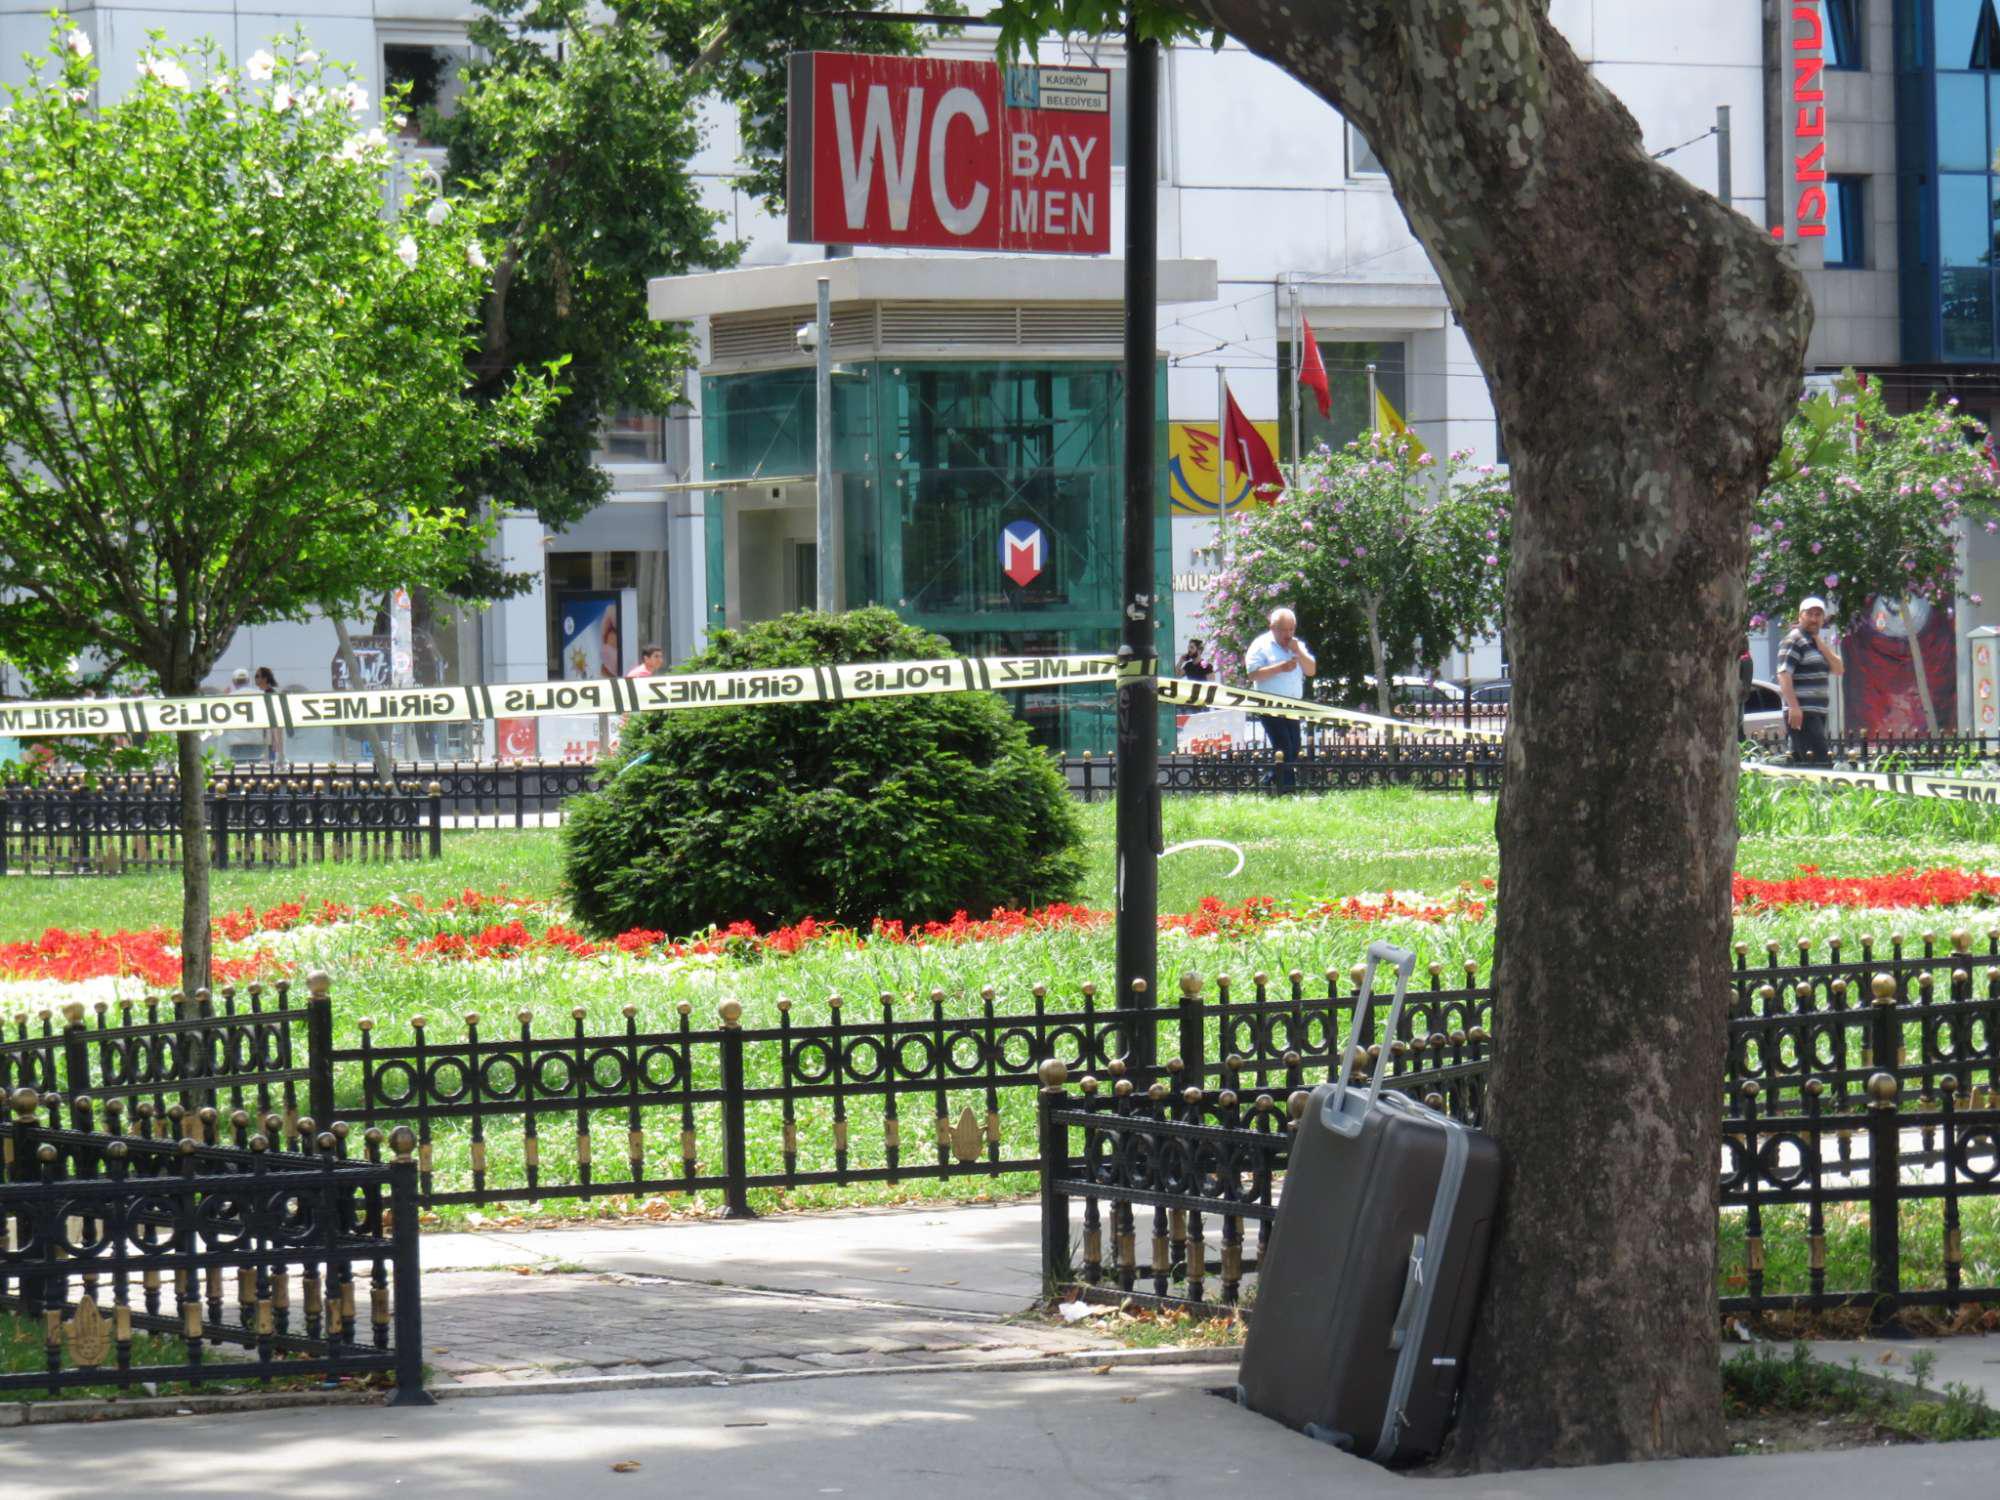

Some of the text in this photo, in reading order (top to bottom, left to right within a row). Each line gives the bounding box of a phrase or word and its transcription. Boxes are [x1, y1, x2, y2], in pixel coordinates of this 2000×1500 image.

[1046, 74, 1088, 87] KADIKÖY
[1771, 0, 1827, 239] İSKEND
[831, 83, 990, 236] WC
[1011, 132, 1098, 180] BAY
[1010, 189, 1096, 236] MEN
